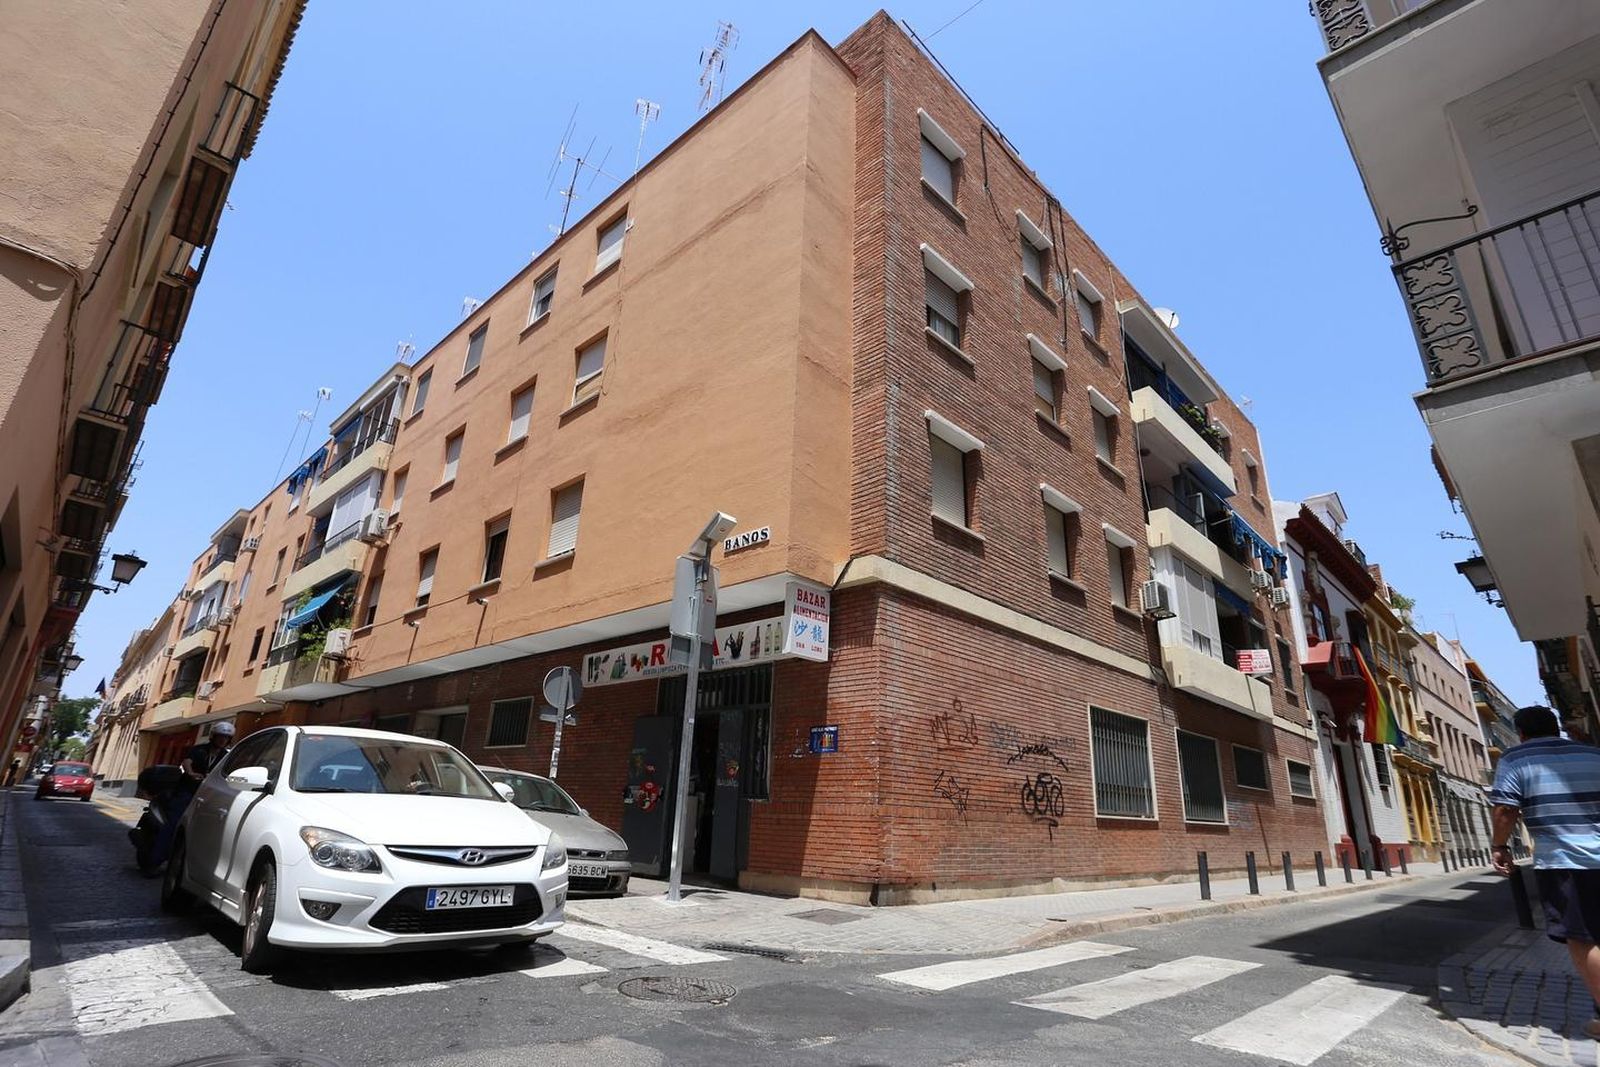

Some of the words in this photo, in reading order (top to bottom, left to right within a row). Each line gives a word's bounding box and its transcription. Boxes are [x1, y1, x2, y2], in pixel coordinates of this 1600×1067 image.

[797, 588, 826, 609] BAZAR
[438, 889, 479, 907] 2497
[481, 888, 508, 905] GYL
